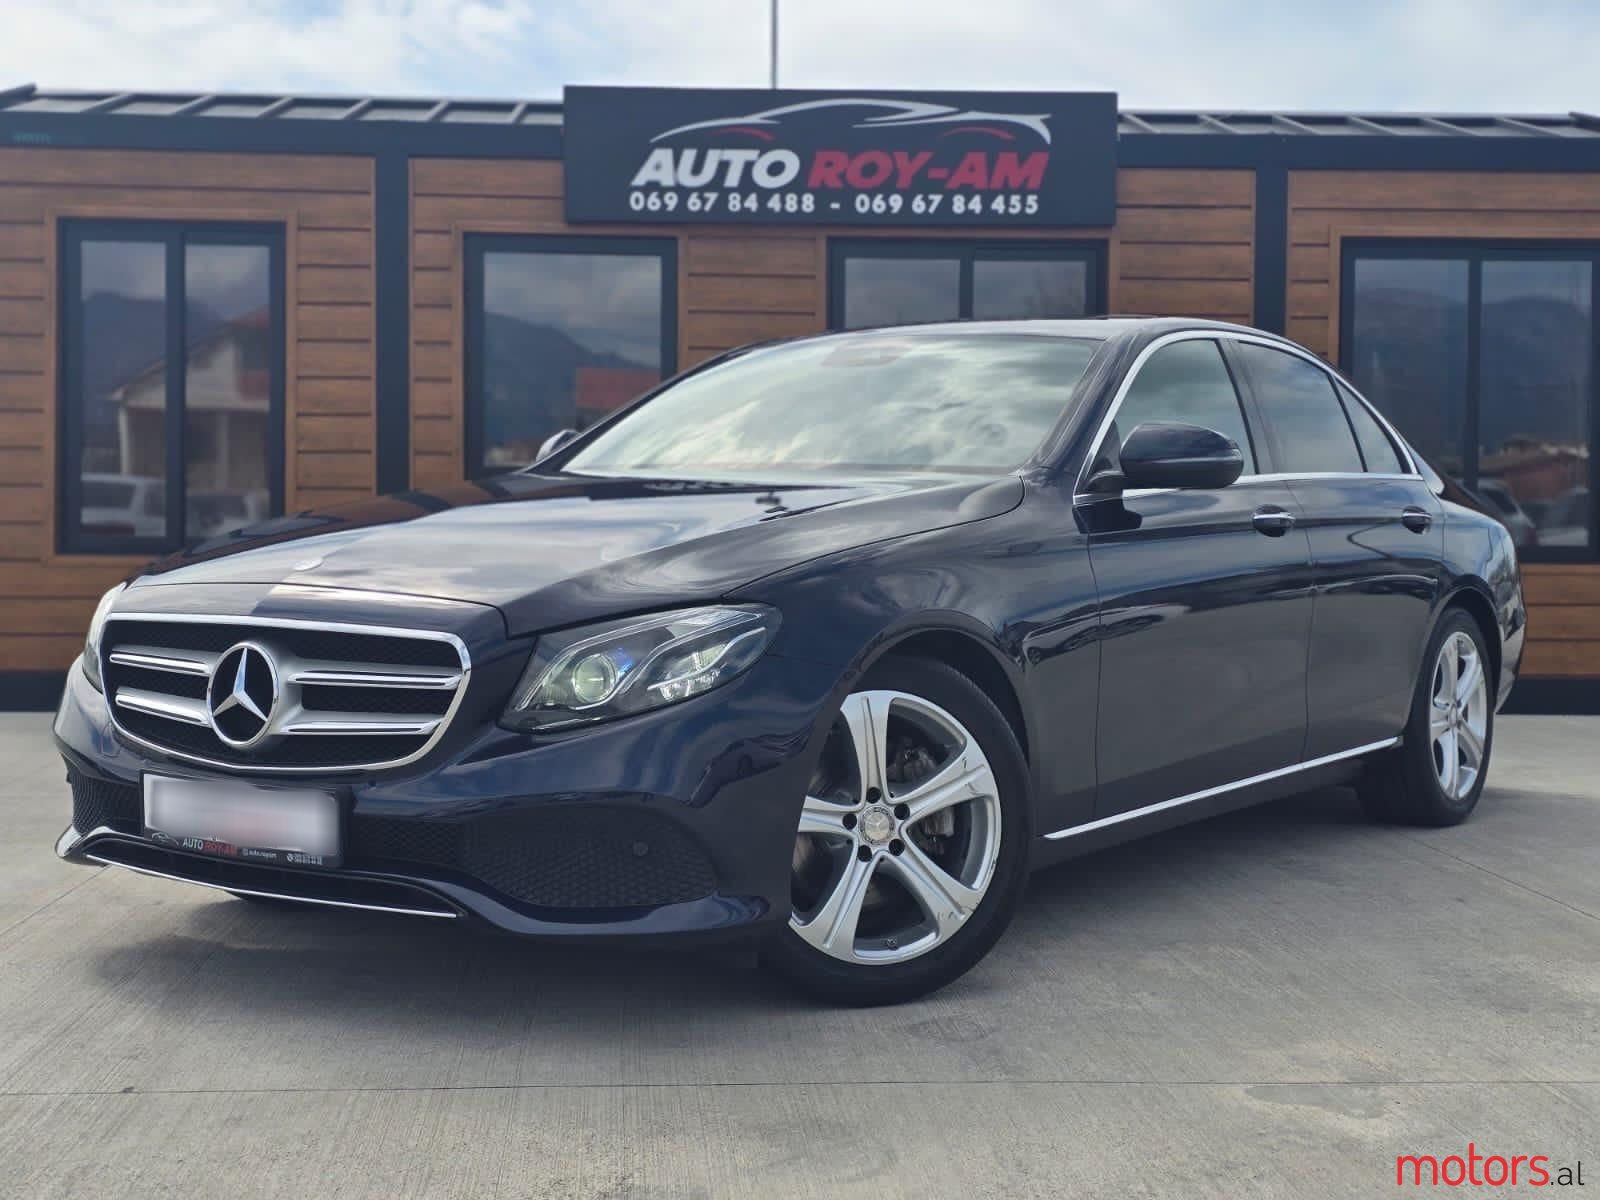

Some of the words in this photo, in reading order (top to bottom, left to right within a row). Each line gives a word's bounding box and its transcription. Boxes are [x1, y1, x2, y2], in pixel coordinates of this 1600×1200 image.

[631, 148, 800, 189] AUTO
[807, 150, 1049, 190] ROY-AM
[629, 191, 679, 212] 069
[687, 192, 719, 212] 67
[727, 193, 759, 213] 84
[767, 193, 815, 214] 488
[855, 193, 903, 214] 069
[911, 194, 943, 214] 67
[951, 194, 982, 215] 84
[990, 194, 1039, 215] 455
[182, 838, 204, 851] AUTO
